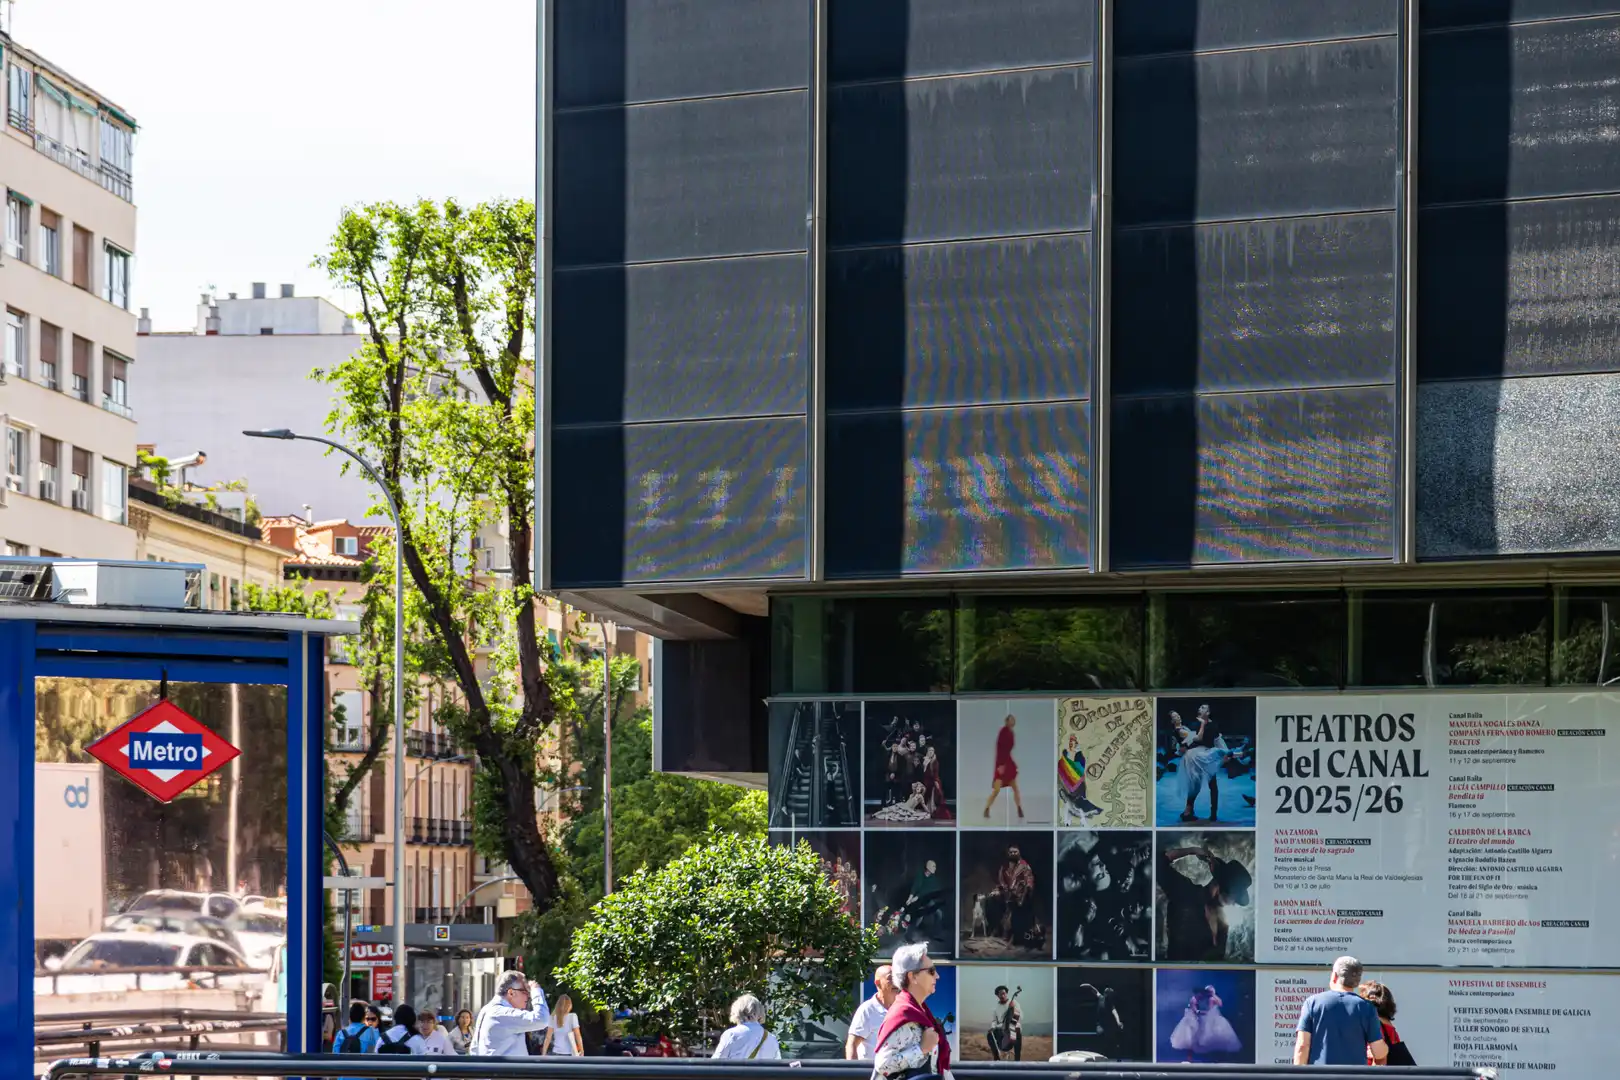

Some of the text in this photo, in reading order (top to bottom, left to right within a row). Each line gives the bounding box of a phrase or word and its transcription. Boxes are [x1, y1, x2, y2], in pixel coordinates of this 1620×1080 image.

[1105, 715, 1125, 732] DE
[1275, 713, 1415, 742] TEATROS
[1449, 728, 1485, 736] COMPAÑÍA
[133, 741, 198, 762] Metro
[1275, 748, 1429, 778] del CANAL
[1275, 784, 1404, 822] 2025/26
[1448, 828, 1485, 836] CALDERÓN
[1327, 847, 1355, 855] sagrado
[1495, 980, 1505, 988] DE
[1484, 1007, 1513, 1015] SONORA
[1551, 1008, 1561, 1016] DE
[1562, 1008, 1591, 1016] GALICIA
[1480, 1025, 1510, 1033] SONORO
[1453, 1043, 1473, 1051] RIOJA
[1528, 1062, 1556, 1070] MADRID
